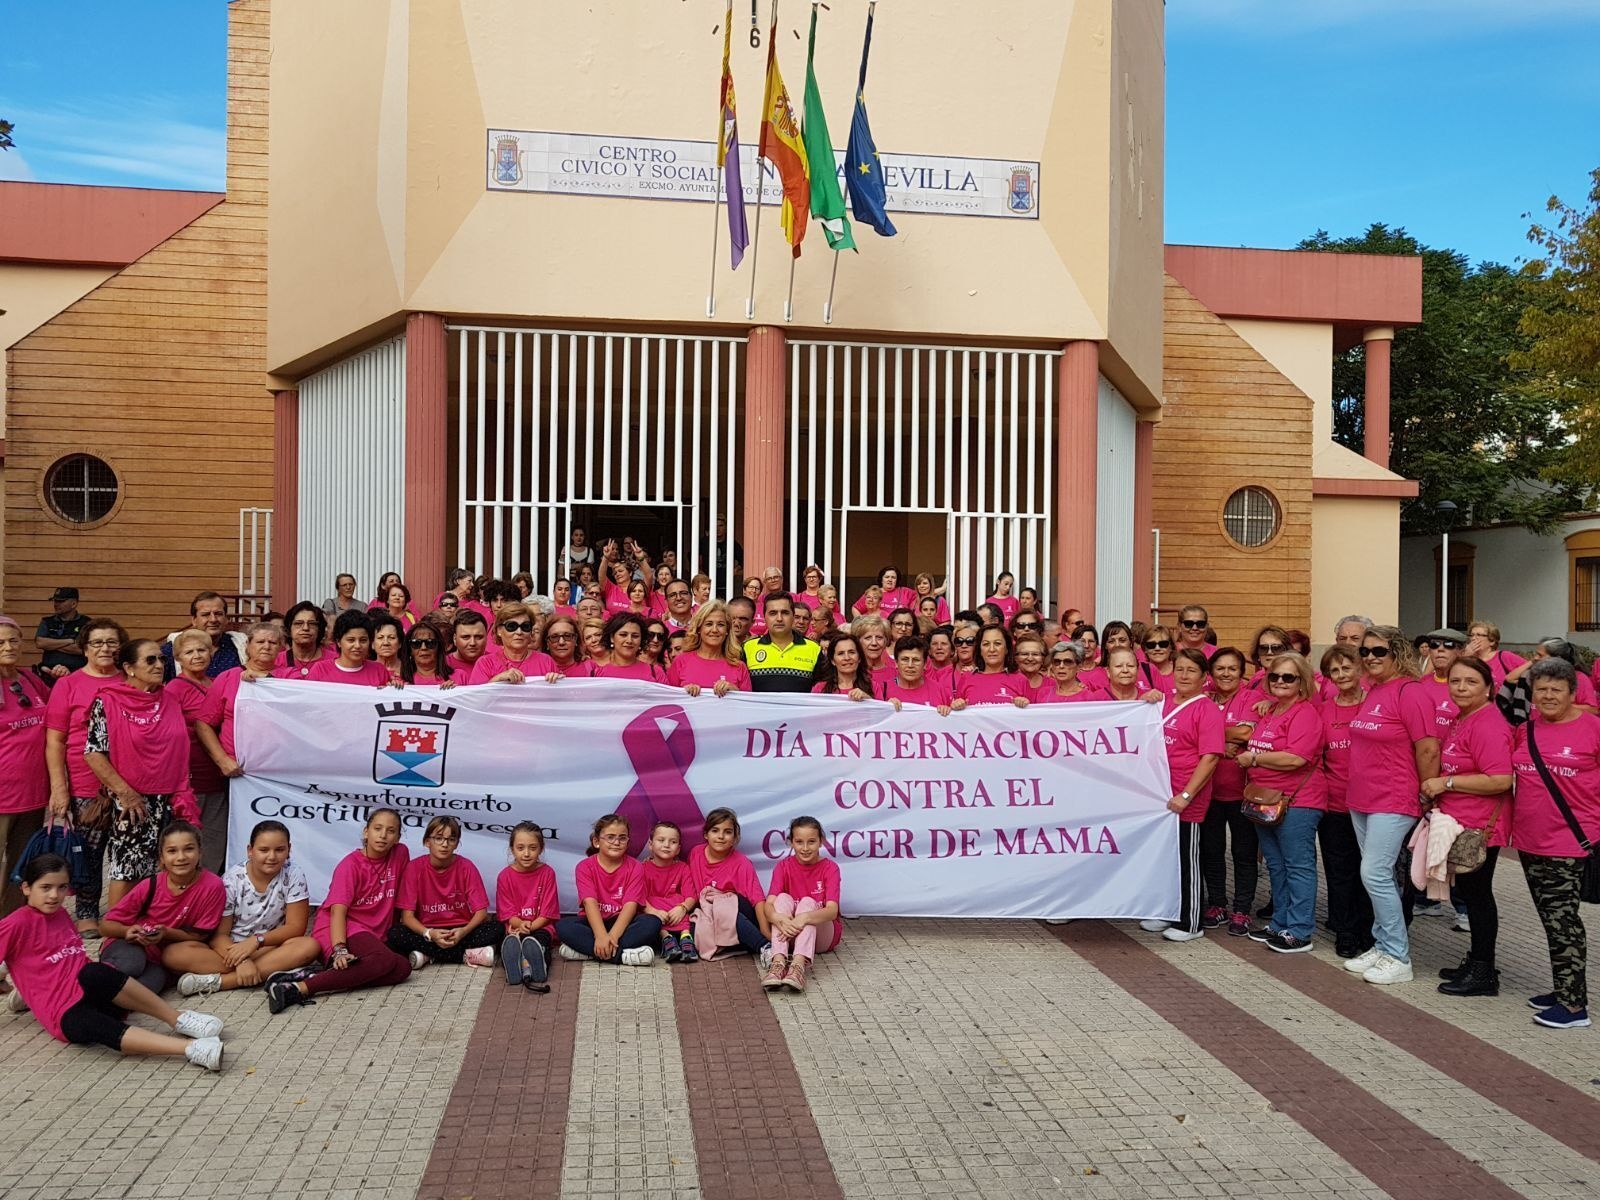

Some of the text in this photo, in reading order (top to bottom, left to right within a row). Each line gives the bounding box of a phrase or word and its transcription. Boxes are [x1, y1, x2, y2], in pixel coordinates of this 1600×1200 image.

[749, 27, 761, 48] 6
[599, 145, 677, 164] CENTRO
[561, 159, 718, 182] CIVICO Y SOCIAL
[884, 165, 979, 192] EVILLA
[639, 181, 677, 191] EXCMO.
[743, 722, 1140, 761] DÍA INTERNACIONAL
[304, 783, 512, 813] Ayuntamiento
[834, 778, 1055, 810] CONTRA EL
[250, 795, 425, 830] Castilla
[762, 825, 1122, 860] CNCER DE MAMA
